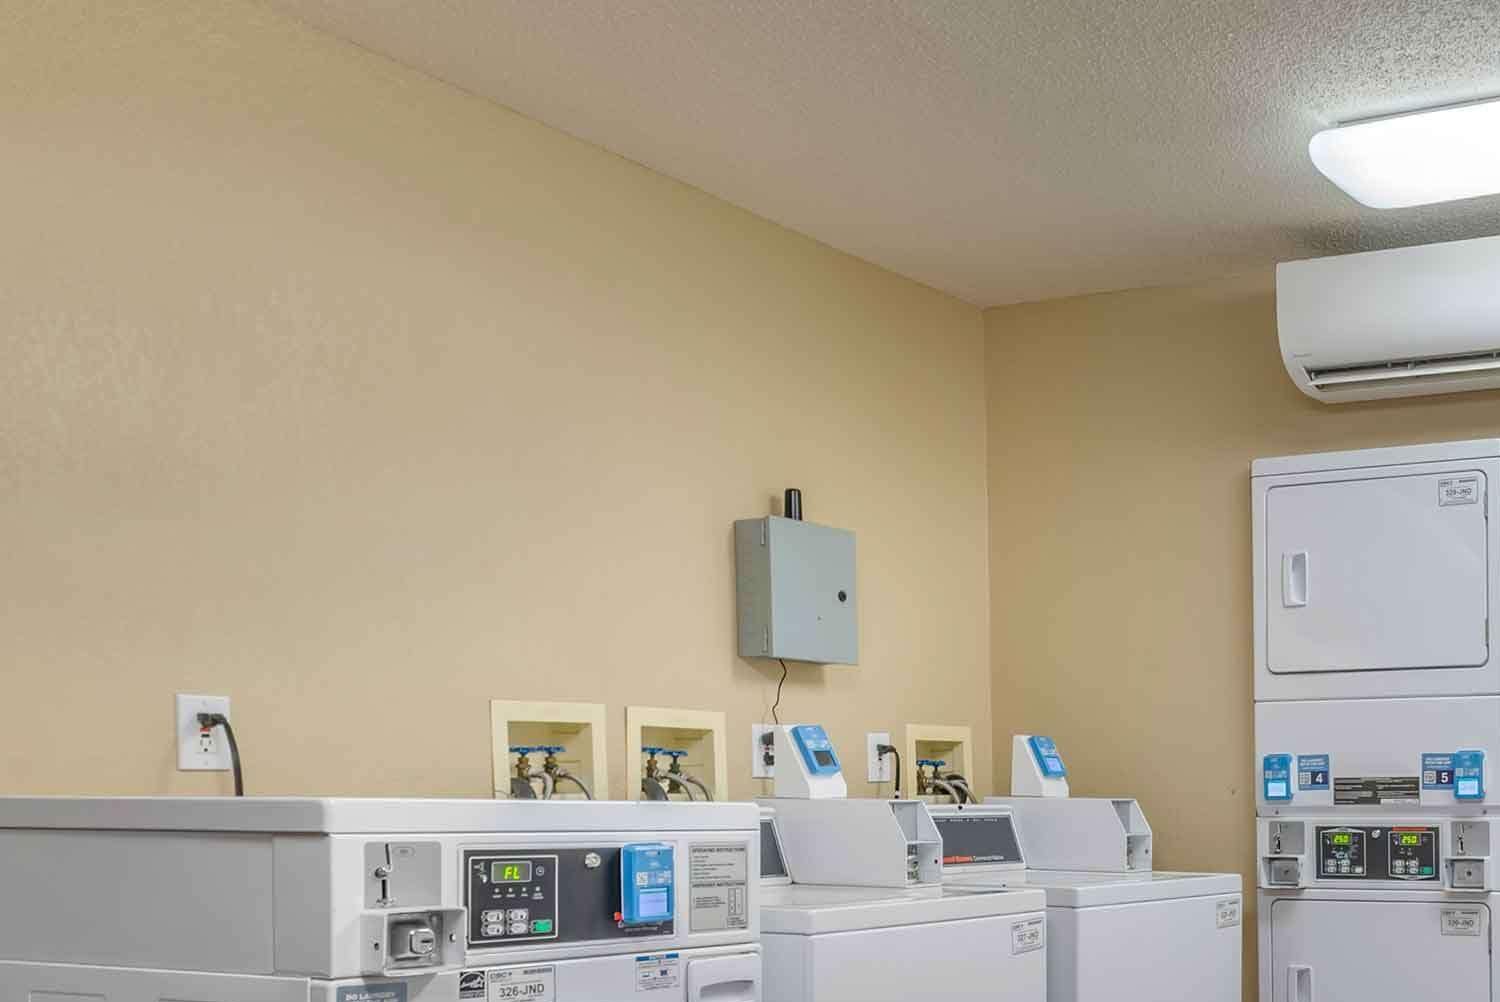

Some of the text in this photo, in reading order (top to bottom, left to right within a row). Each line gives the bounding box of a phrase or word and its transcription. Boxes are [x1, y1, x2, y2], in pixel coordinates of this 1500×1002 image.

[1315, 773, 1323, 784] 4
[1441, 772, 1449, 783] 5
[503, 866, 520, 880] FL
[499, 983, 545, 998] 326-JND
